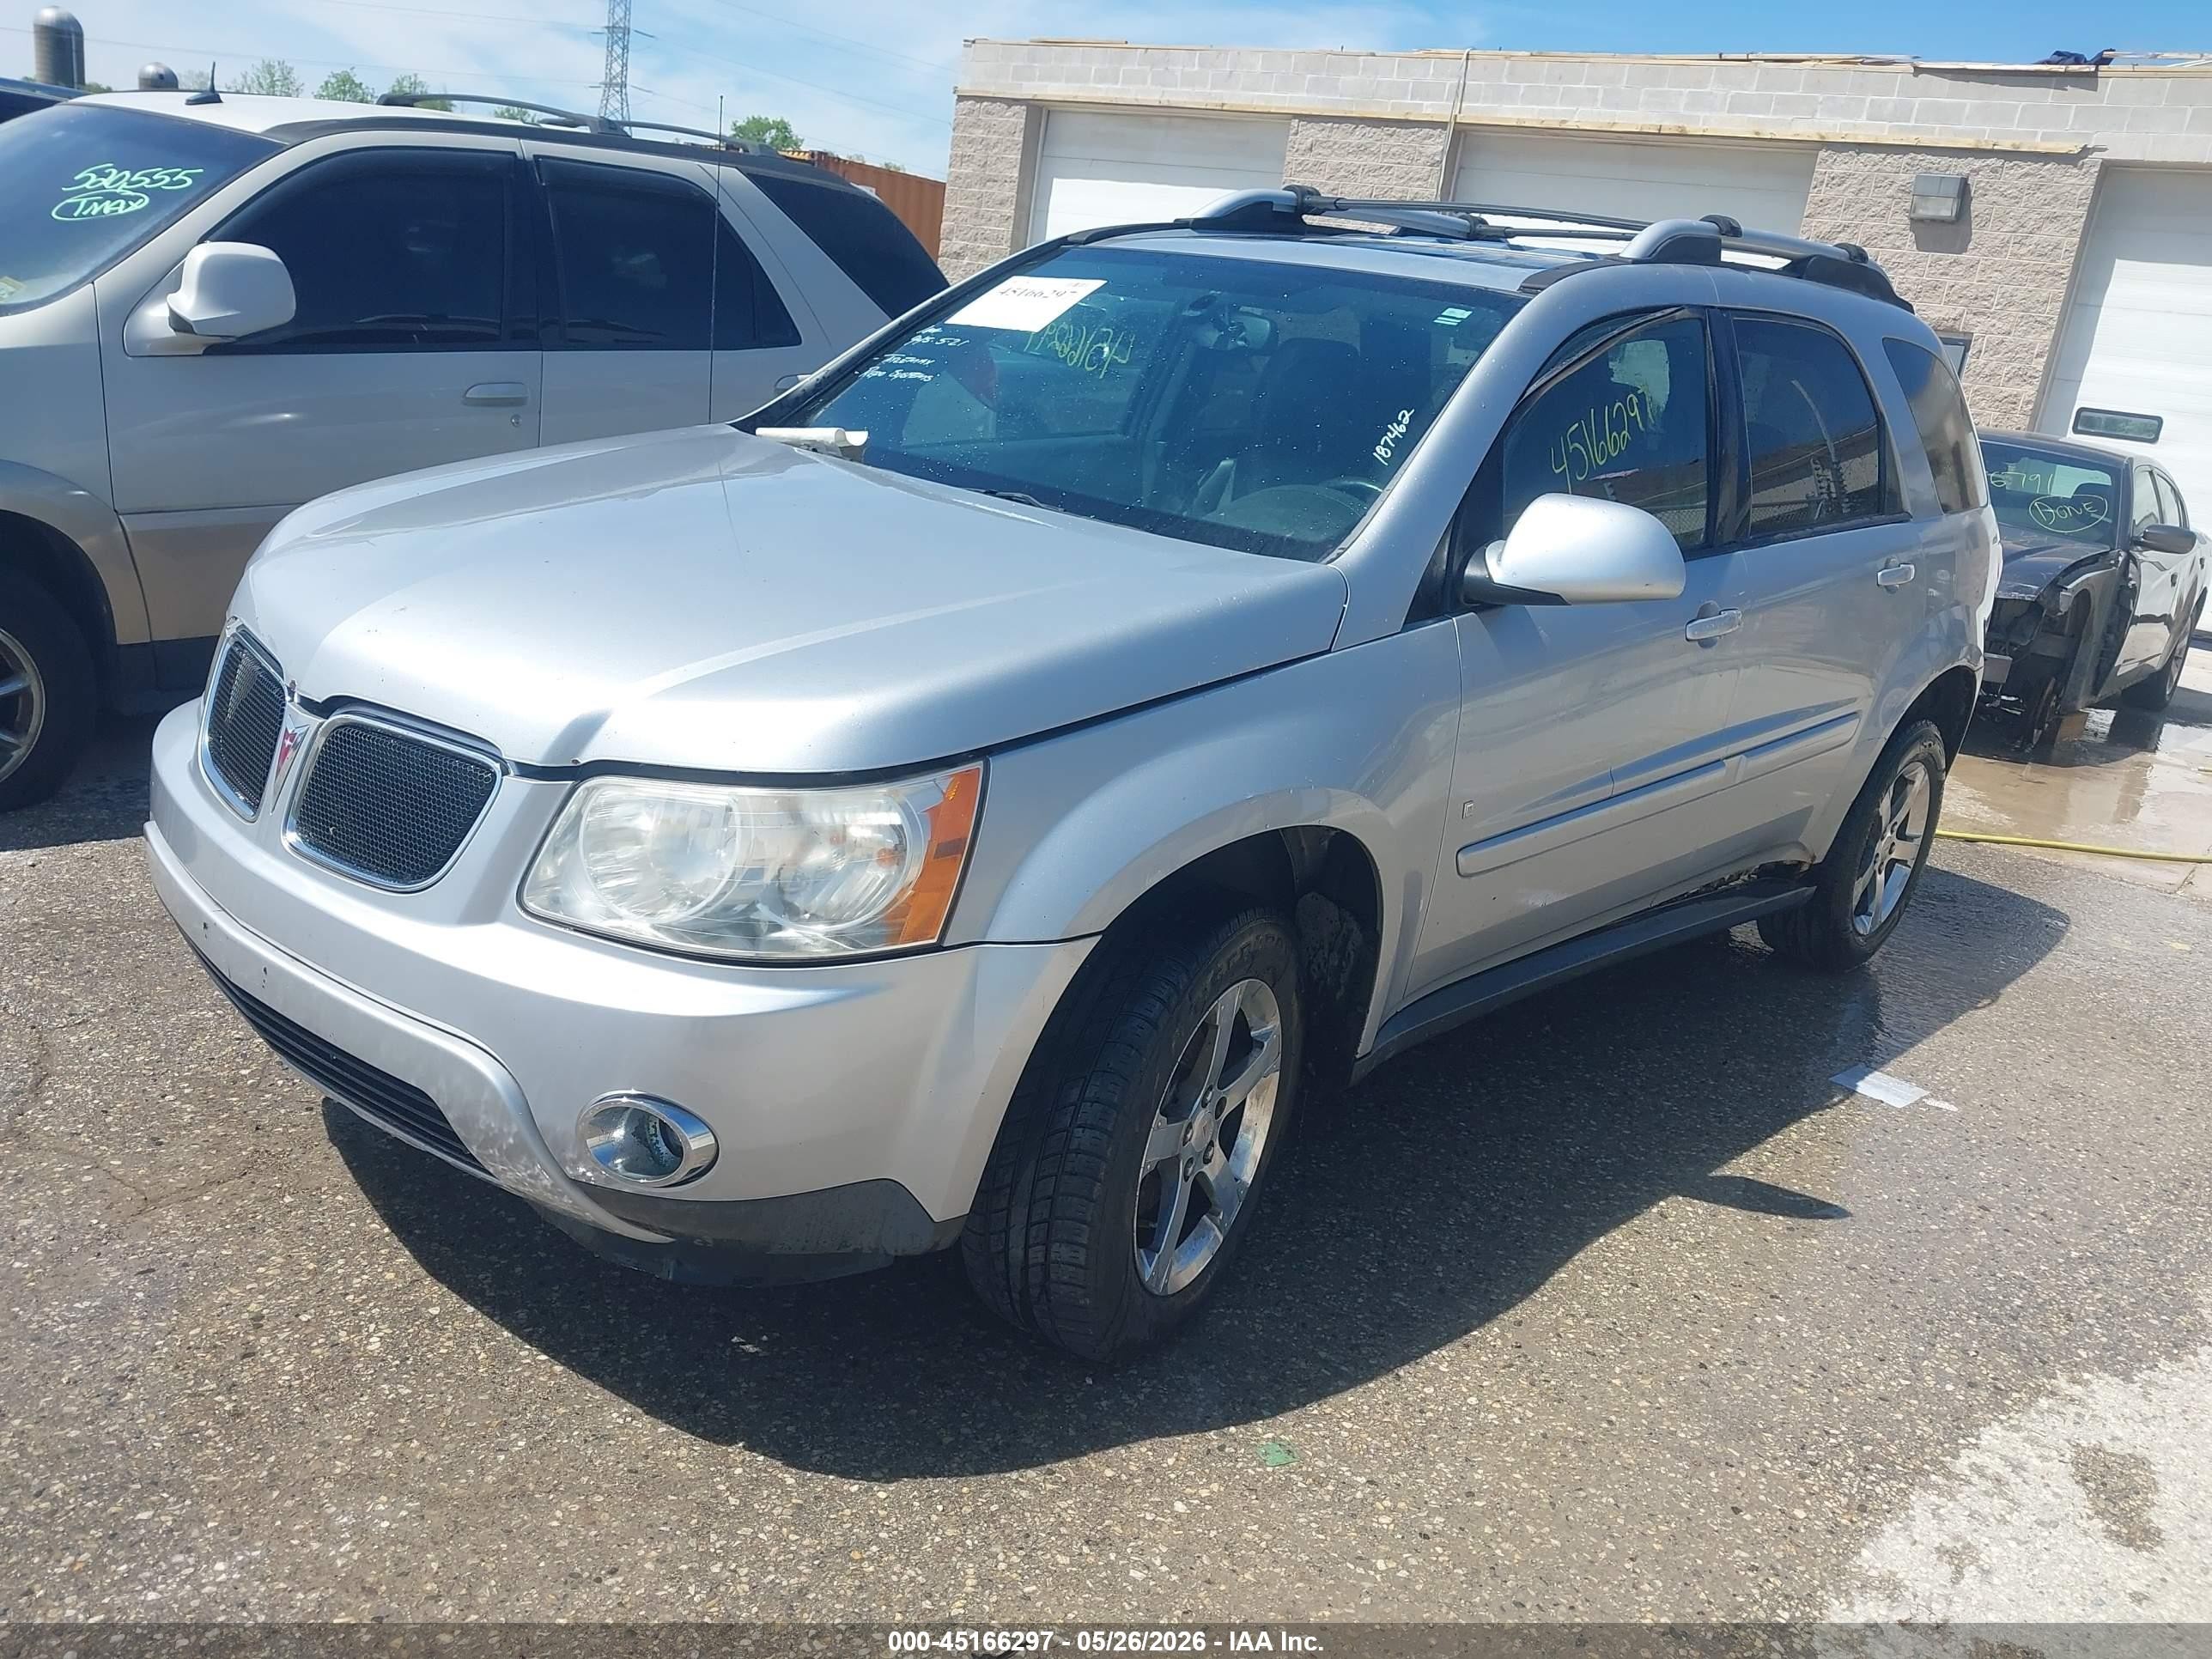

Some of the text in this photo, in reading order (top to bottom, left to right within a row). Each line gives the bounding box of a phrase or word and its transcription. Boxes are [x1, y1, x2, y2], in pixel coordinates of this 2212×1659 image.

[67, 197, 144, 217] TMAX
[1372, 409, 1415, 465] 187462
[1551, 386, 1656, 495] 45166297
